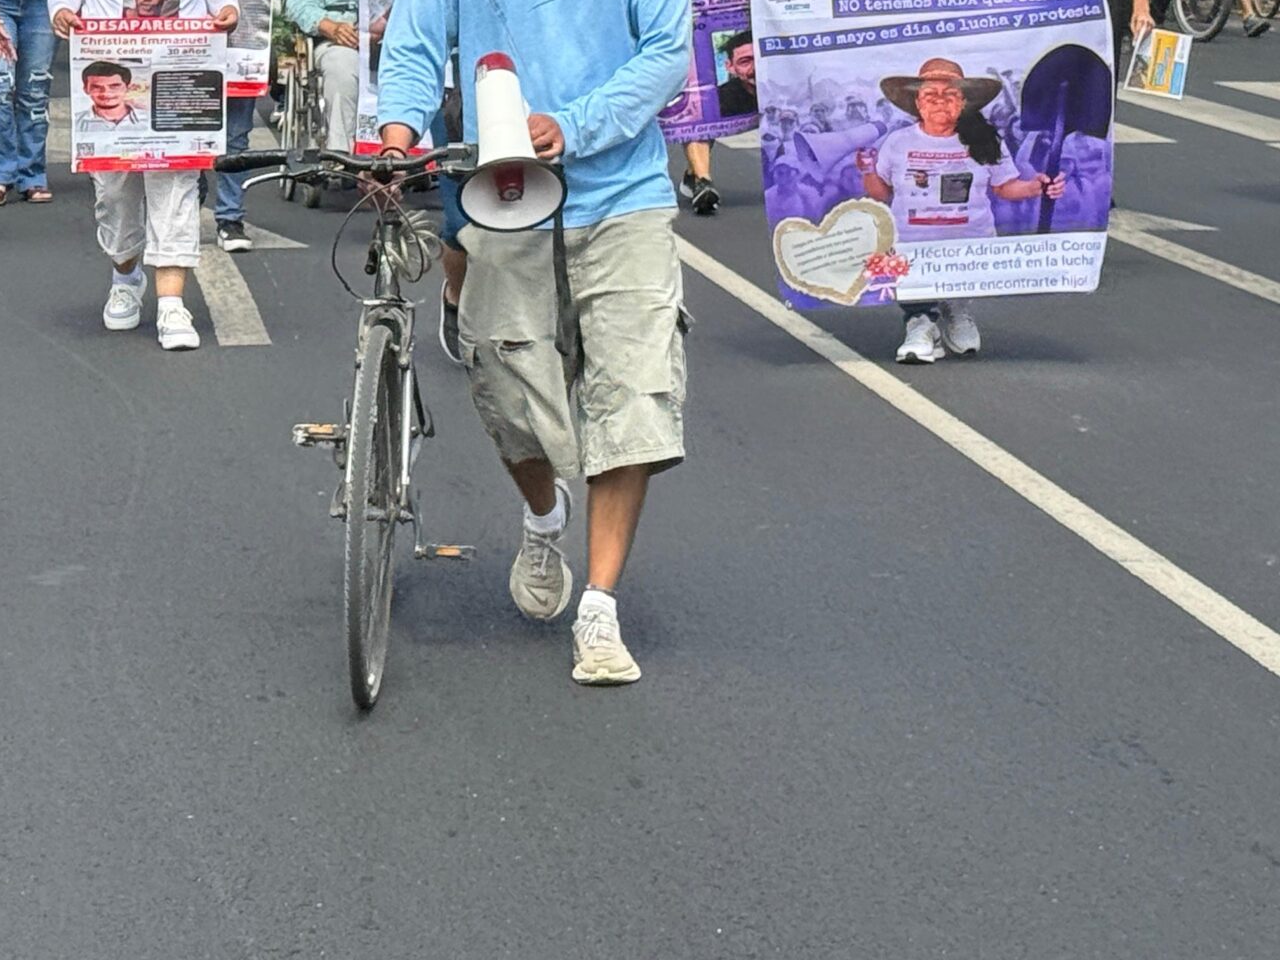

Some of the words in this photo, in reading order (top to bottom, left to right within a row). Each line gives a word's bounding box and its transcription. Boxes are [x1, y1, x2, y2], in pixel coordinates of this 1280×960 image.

[838, 0, 860, 13] NO
[86, 19, 216, 32] DESAPARECIDO
[765, 38, 786, 51] El
[789, 37, 809, 49] 10
[812, 34, 832, 47] de
[836, 30, 876, 45] mayo
[879, 27, 898, 39] es
[935, 21, 956, 33] de
[958, 13, 1010, 31] lucha
[1013, 13, 1025, 28] y
[1027, 4, 1102, 26] protesta
[80, 36, 138, 46] Christian
[140, 35, 209, 46] Emmanuel
[181, 46, 208, 56] años
[914, 245, 961, 260] Héctor
[945, 258, 990, 272] madre
[992, 256, 1021, 270] está
[1025, 258, 1043, 269] en
[1045, 255, 1059, 267] la
[1061, 254, 1095, 267] lucha
[934, 280, 976, 293] Hasta
[979, 276, 1058, 290] encontrarte
